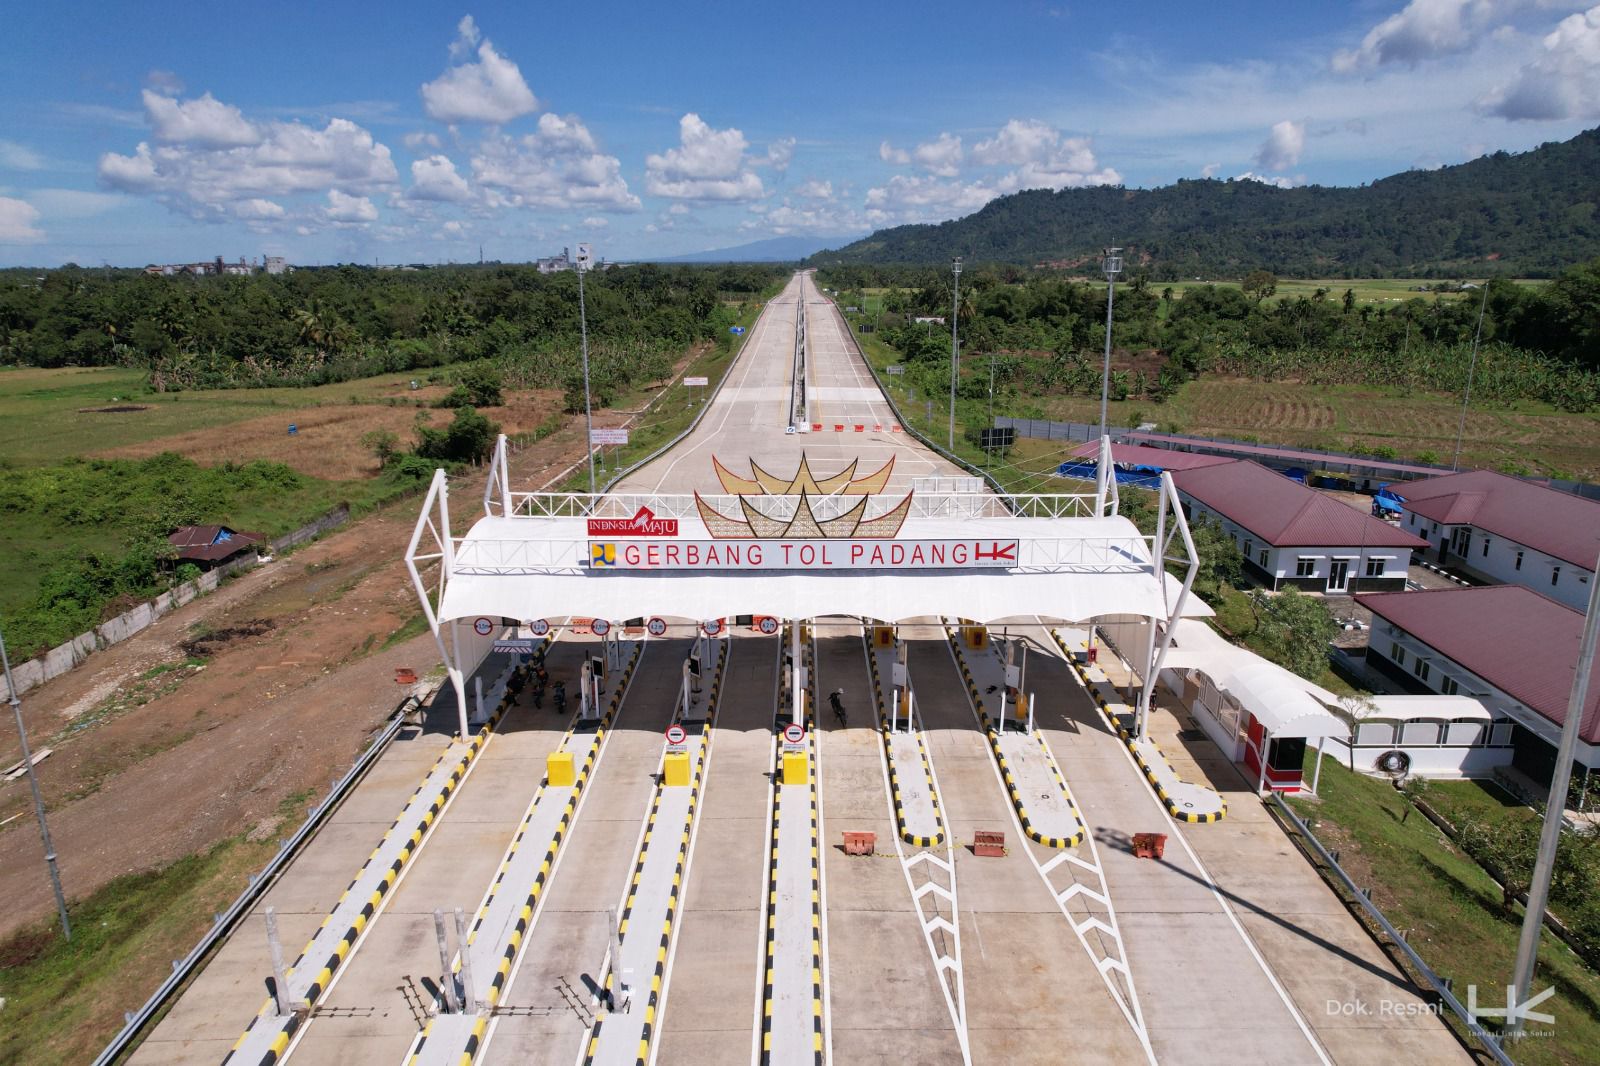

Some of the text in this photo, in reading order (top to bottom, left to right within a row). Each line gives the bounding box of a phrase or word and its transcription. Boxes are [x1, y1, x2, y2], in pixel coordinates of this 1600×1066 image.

[641, 521, 676, 535] MAJU
[625, 544, 968, 565] GERBANG TOL PADANG
[975, 542, 1016, 560] HK
